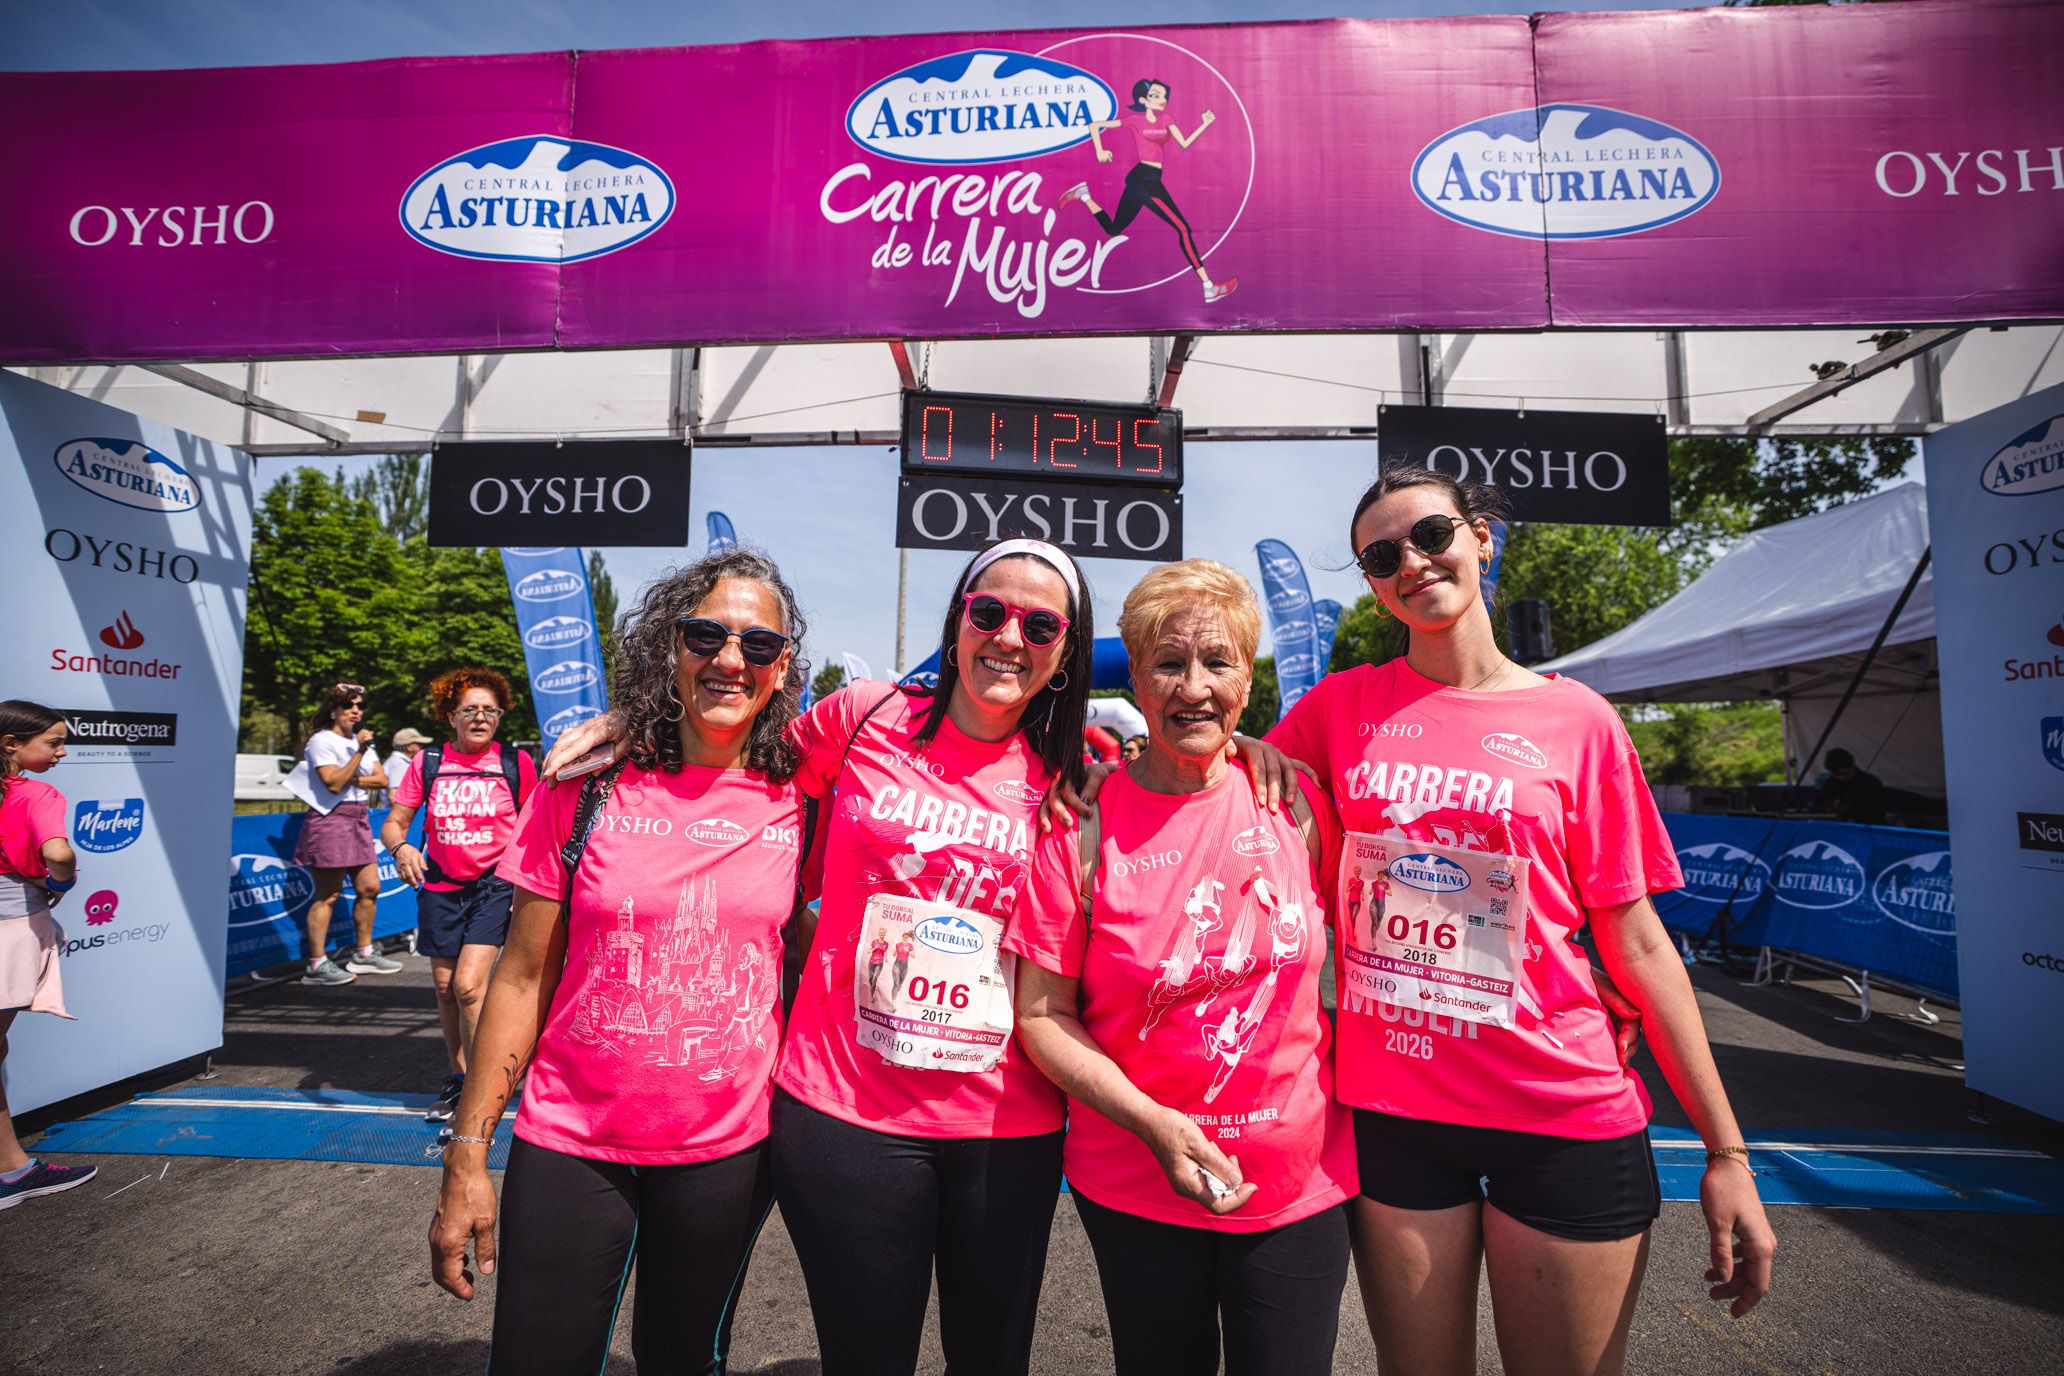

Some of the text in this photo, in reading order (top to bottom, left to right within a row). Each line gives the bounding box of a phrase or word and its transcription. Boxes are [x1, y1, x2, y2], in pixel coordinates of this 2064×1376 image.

[909, 84, 1087, 103] CENTRAL LECHERA
[867, 97, 1093, 138] ASTURIANA
[1481, 146, 1684, 164] CENTRAL LECHERA
[464, 177, 554, 191] CENTRAL
[1437, 153, 1697, 202] ASTURIANA
[1874, 146, 2064, 197] OYSH
[420, 183, 652, 230] ASTURIANA
[820, 162, 1043, 225] Carrera
[69, 200, 275, 246] OYSHO
[872, 207, 1129, 319] de la Mujer
[922, 406, 1162, 473] 01:12:45
[66, 449, 193, 505] ASTURIANA
[1426, 445, 1627, 492] OYSHO
[470, 475, 650, 515] OYSHO
[912, 489, 1170, 551] OYSHO
[44, 528, 199, 584] OYSHO
[1984, 529, 2064, 576] OYS
[51, 649, 182, 680] Santander
[2004, 655, 2064, 681] Sant
[65, 717, 168, 742] Neutrogena
[1359, 723, 1423, 738] OYSHO
[880, 753, 944, 777] OYSHO
[1486, 737, 1541, 767] ASTURIANA
[436, 780, 497, 803] HOY
[1349, 760, 1514, 822] CARRERA
[78, 810, 139, 840] Marlene
[435, 818, 466, 831] LAS
[690, 826, 744, 841] ASTURIANA
[870, 785, 1027, 860] CARRERA
[437, 831, 493, 845] CHICAS
[1113, 849, 1183, 877] OYSHO
[1356, 848, 1387, 861] SUMA
[1395, 863, 1464, 886] ASTURIANA
[1684, 868, 1761, 892] STURIANA
[229, 880, 308, 910] TURIANA
[1881, 874, 1955, 914] ASTURI
[882, 910, 913, 923] SUMA
[66, 923, 171, 958] pus energy
[919, 925, 978, 948] ASTURIANA
[1388, 915, 1457, 949] 016
[1403, 948, 1437, 965] 2018
[2022, 952, 2064, 972] octo
[1351, 969, 1396, 993] OYSHO
[1370, 957, 1380, 967] DE
[1382, 960, 1392, 970] LA
[1394, 962, 1424, 976] MUJER
[1431, 969, 1509, 994] VITORIA-GASTEIZ
[909, 976, 969, 1009] 016
[1434, 993, 1492, 1012] Santander
[921, 1009, 952, 1024] 2017
[872, 1030, 913, 1054] OYSHO
[889, 1020, 899, 1029] DE
[901, 1022, 910, 1031] LA
[912, 1024, 939, 1036] MUJER
[945, 1029, 1002, 1044] VITORIA-GASTEIZ
[1385, 1028, 1433, 1060] 2026
[944, 1051, 984, 1062] Santander
[1221, 1115, 1232, 1125] DE
[1235, 1114, 1246, 1124] LA
[1248, 1108, 1278, 1123] MUJER
[1217, 1127, 1241, 1138] 2024
